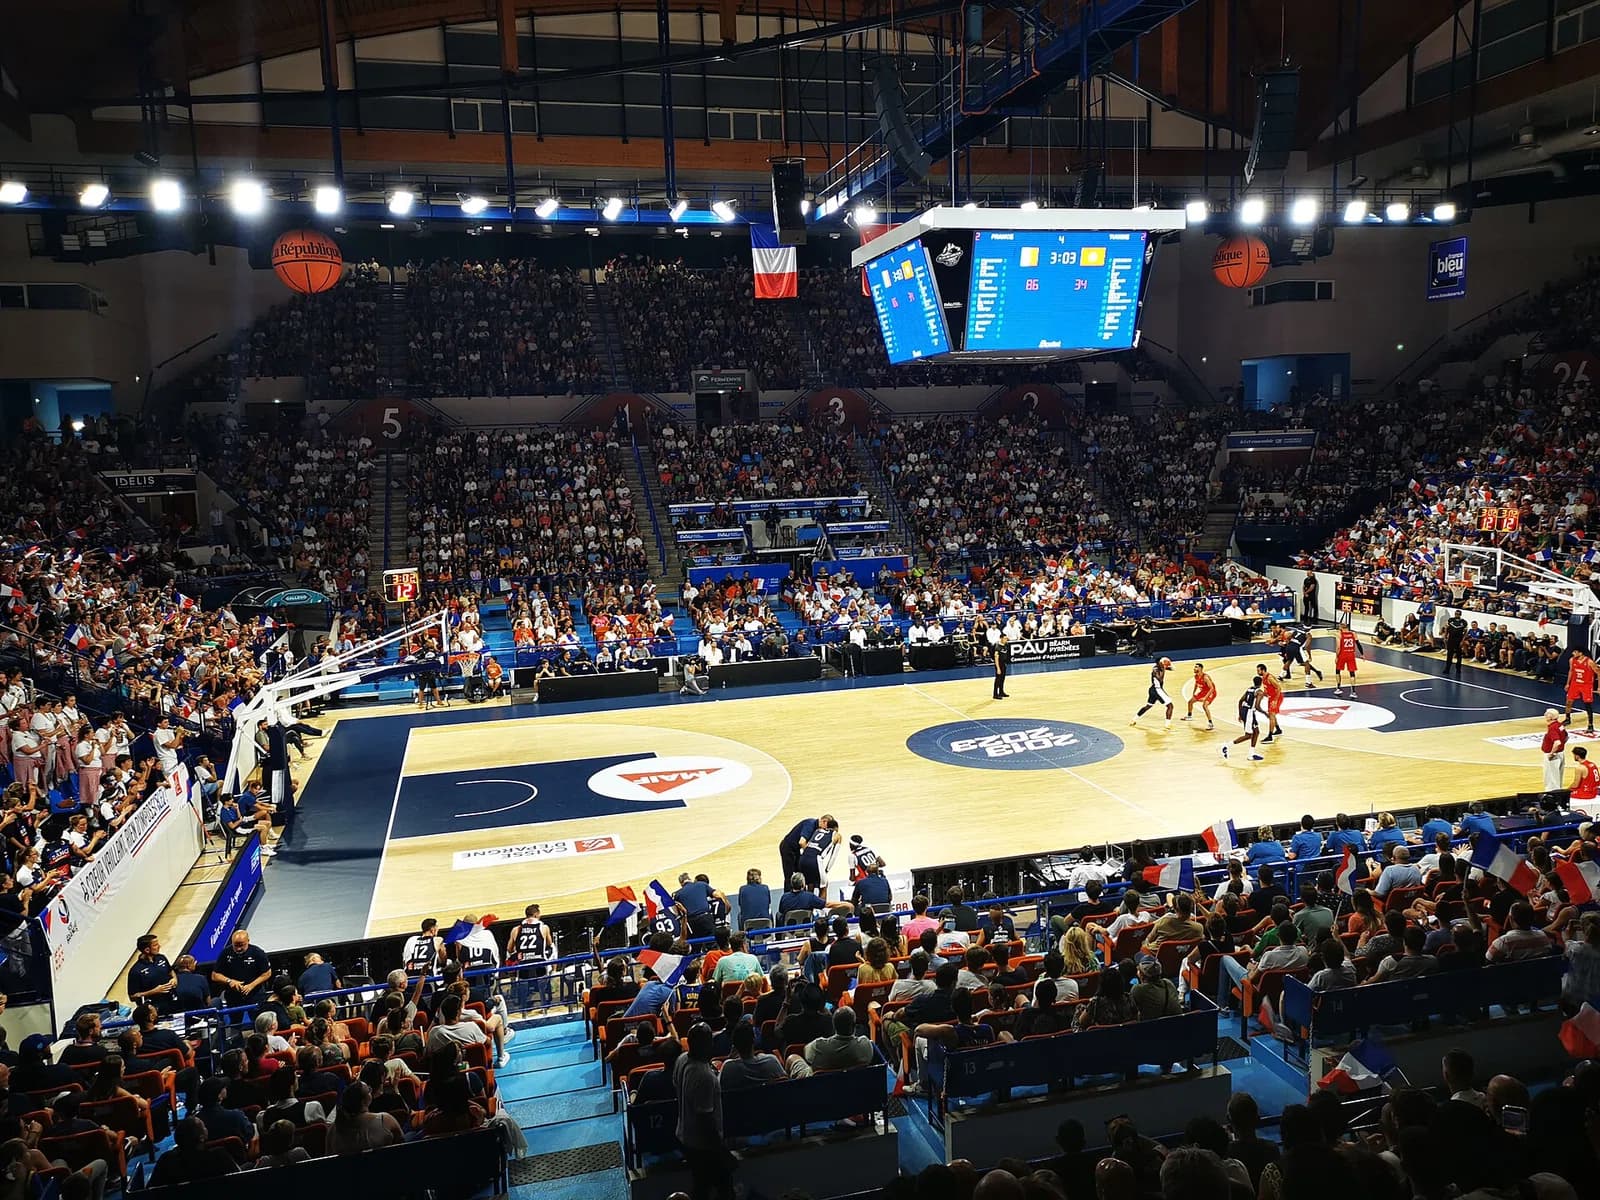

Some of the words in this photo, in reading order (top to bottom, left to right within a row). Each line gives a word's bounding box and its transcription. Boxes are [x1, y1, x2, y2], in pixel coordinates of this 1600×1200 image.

[1050, 252, 1077, 265] 3:03
[1437, 257, 1463, 273] bleu
[1025, 279, 1039, 290] 86
[1074, 279, 1088, 290] 34
[382, 408, 402, 439] 5
[115, 476, 155, 486] IDELIS
[1503, 518, 1514, 529] 12
[397, 584, 412, 598] 12
[1010, 641, 1048, 656] PAU
[1344, 638, 1354, 648] 23
[950, 726, 1054, 752] 2023
[633, 771, 708, 785] MAIF
[502, 847, 568, 859] CAISSE
[861, 854, 876, 865] 00
[656, 919, 675, 933] 93
[520, 935, 537, 950] 22
[414, 945, 428, 959] 12
